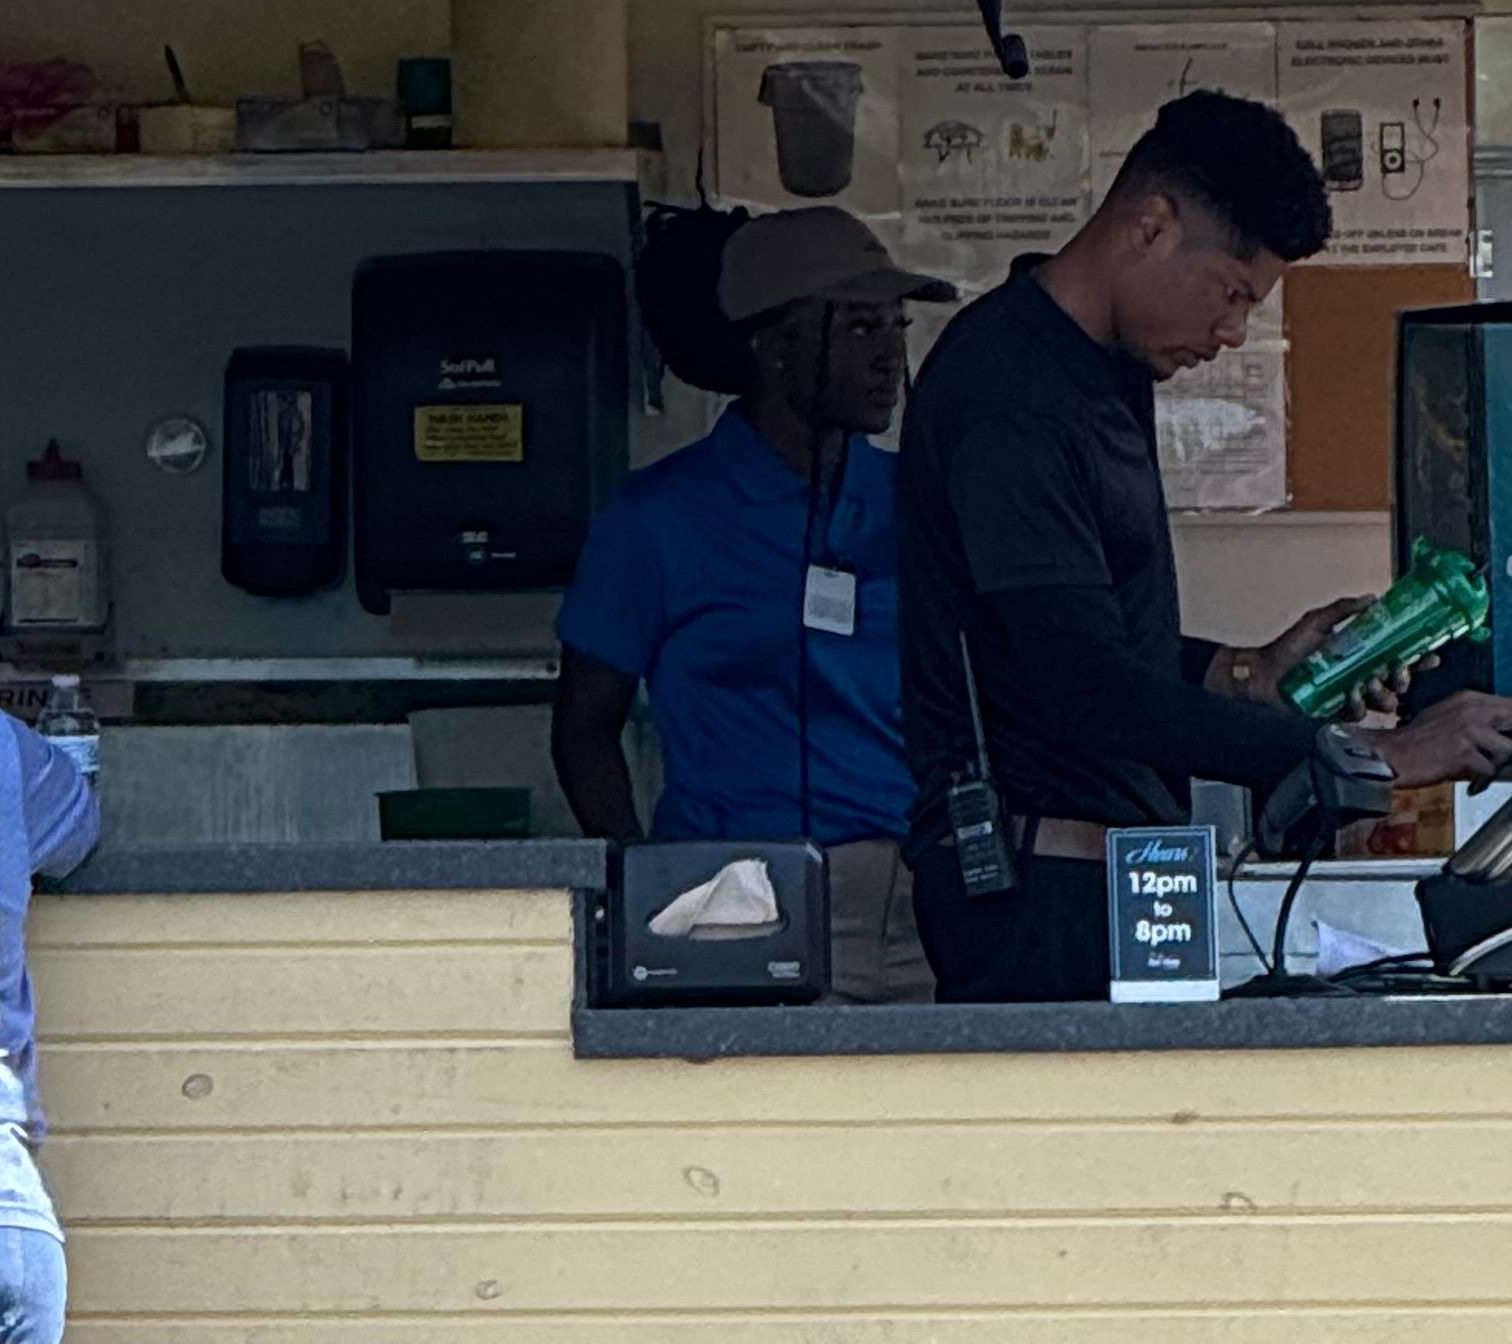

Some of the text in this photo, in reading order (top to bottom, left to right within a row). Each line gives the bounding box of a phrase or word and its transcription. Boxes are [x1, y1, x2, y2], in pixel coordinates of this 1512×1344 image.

[1128, 870, 1197, 898] 12pm
[1153, 900, 1173, 917] to
[1135, 920, 1192, 947] 8pm
